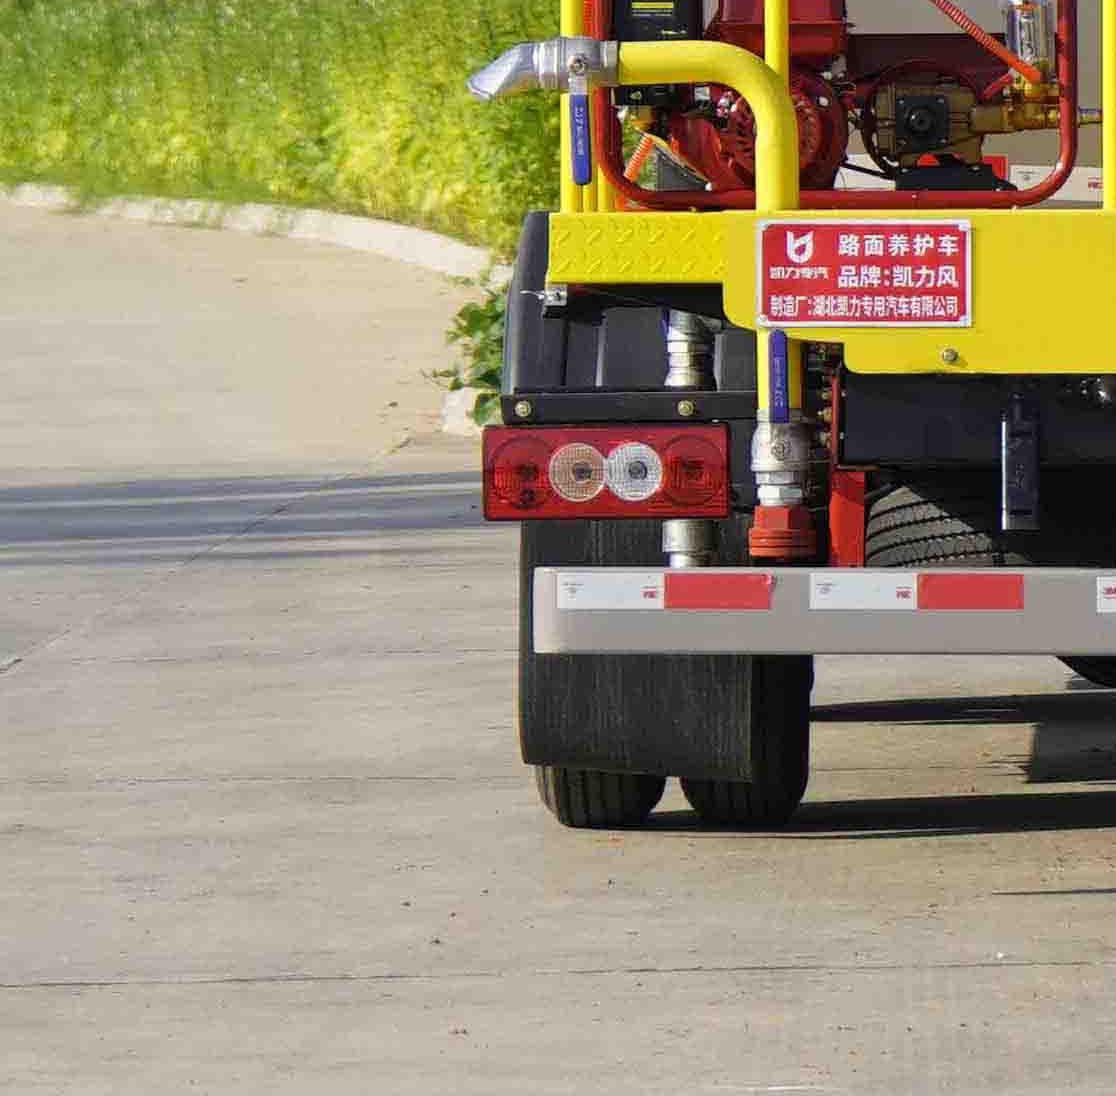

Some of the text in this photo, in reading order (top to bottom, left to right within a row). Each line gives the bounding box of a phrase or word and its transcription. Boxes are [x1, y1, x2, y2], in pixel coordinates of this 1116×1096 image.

[838, 233, 959, 256] 路面养护车
